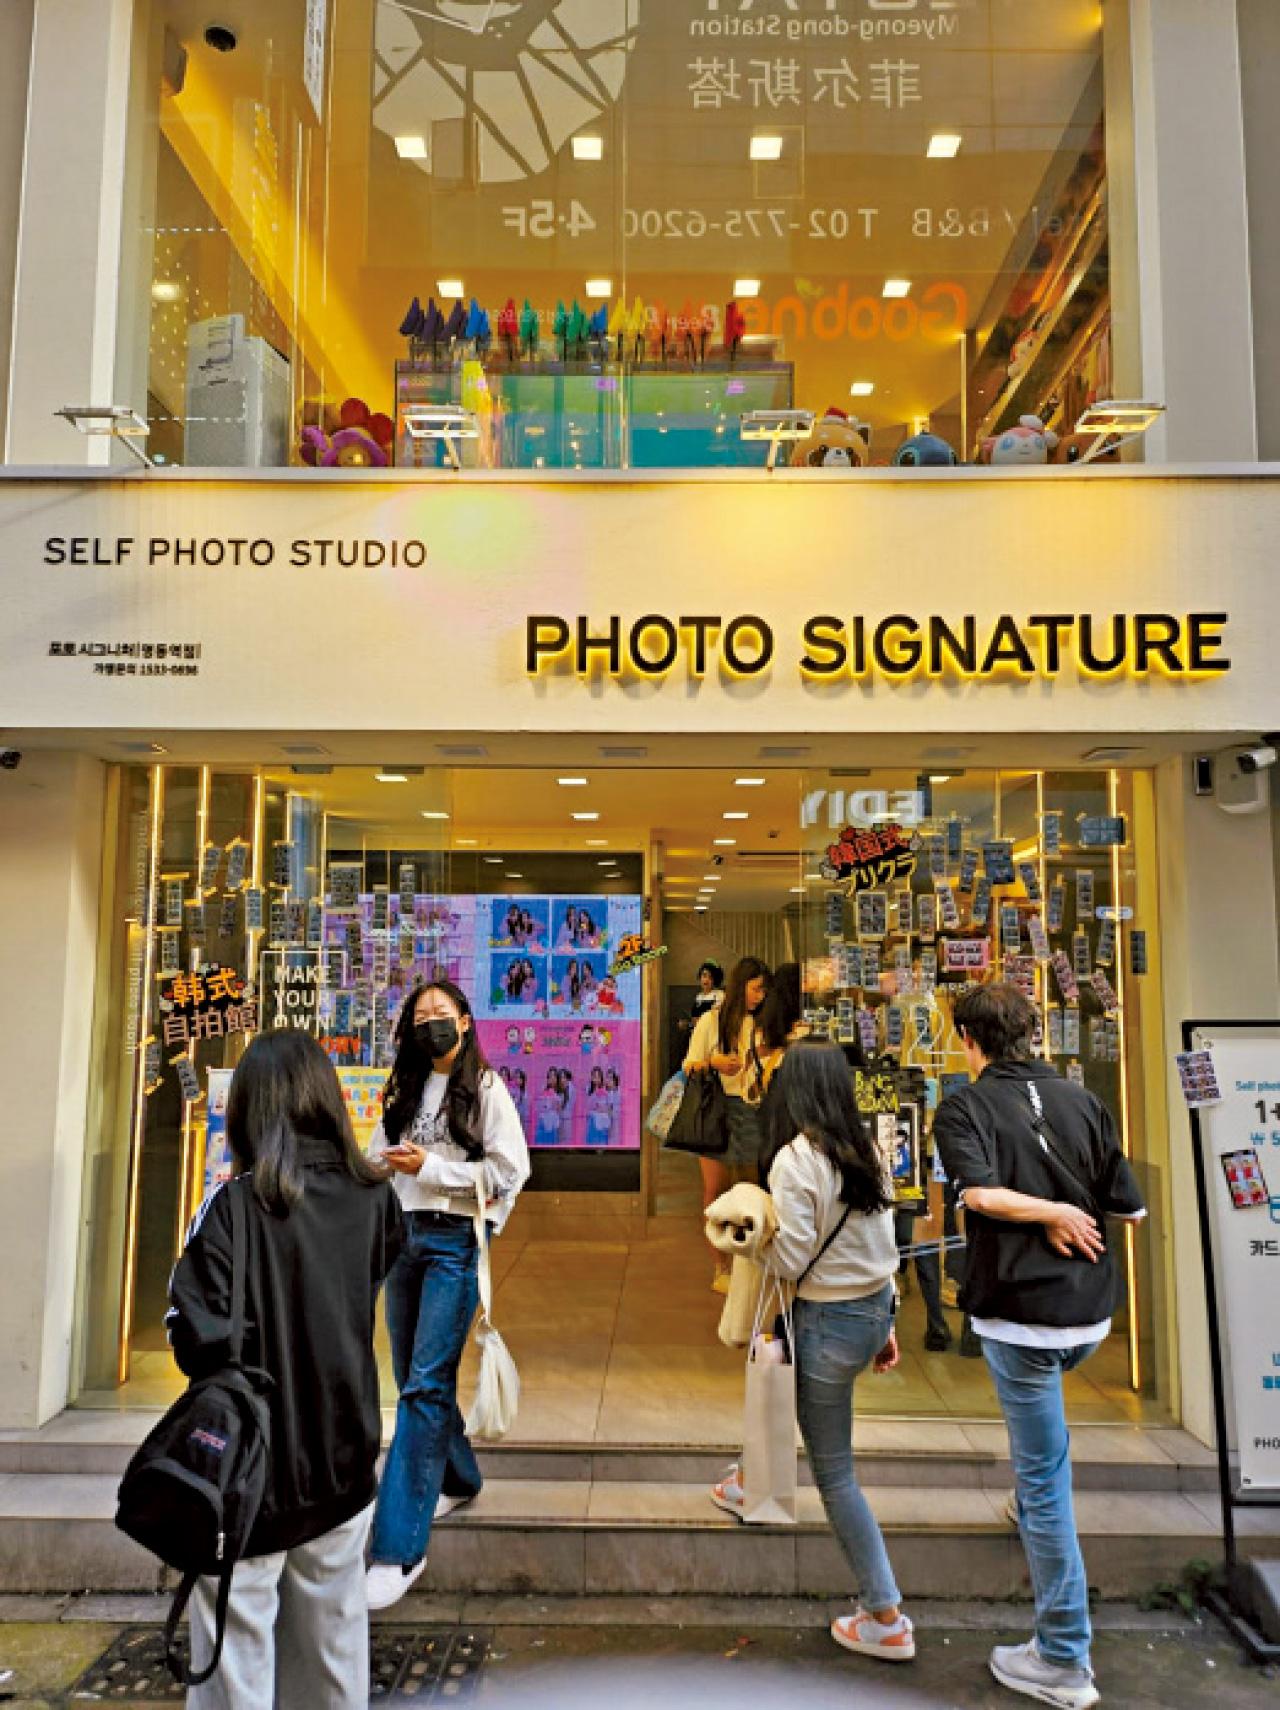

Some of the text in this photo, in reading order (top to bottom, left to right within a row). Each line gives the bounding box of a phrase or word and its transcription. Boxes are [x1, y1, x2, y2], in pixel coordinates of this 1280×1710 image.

[44, 537, 427, 569] SELF PHOTO STUDIO
[526, 612, 1231, 674] PHOTO SIGNATURE
[274, 965, 332, 984] MAKE
